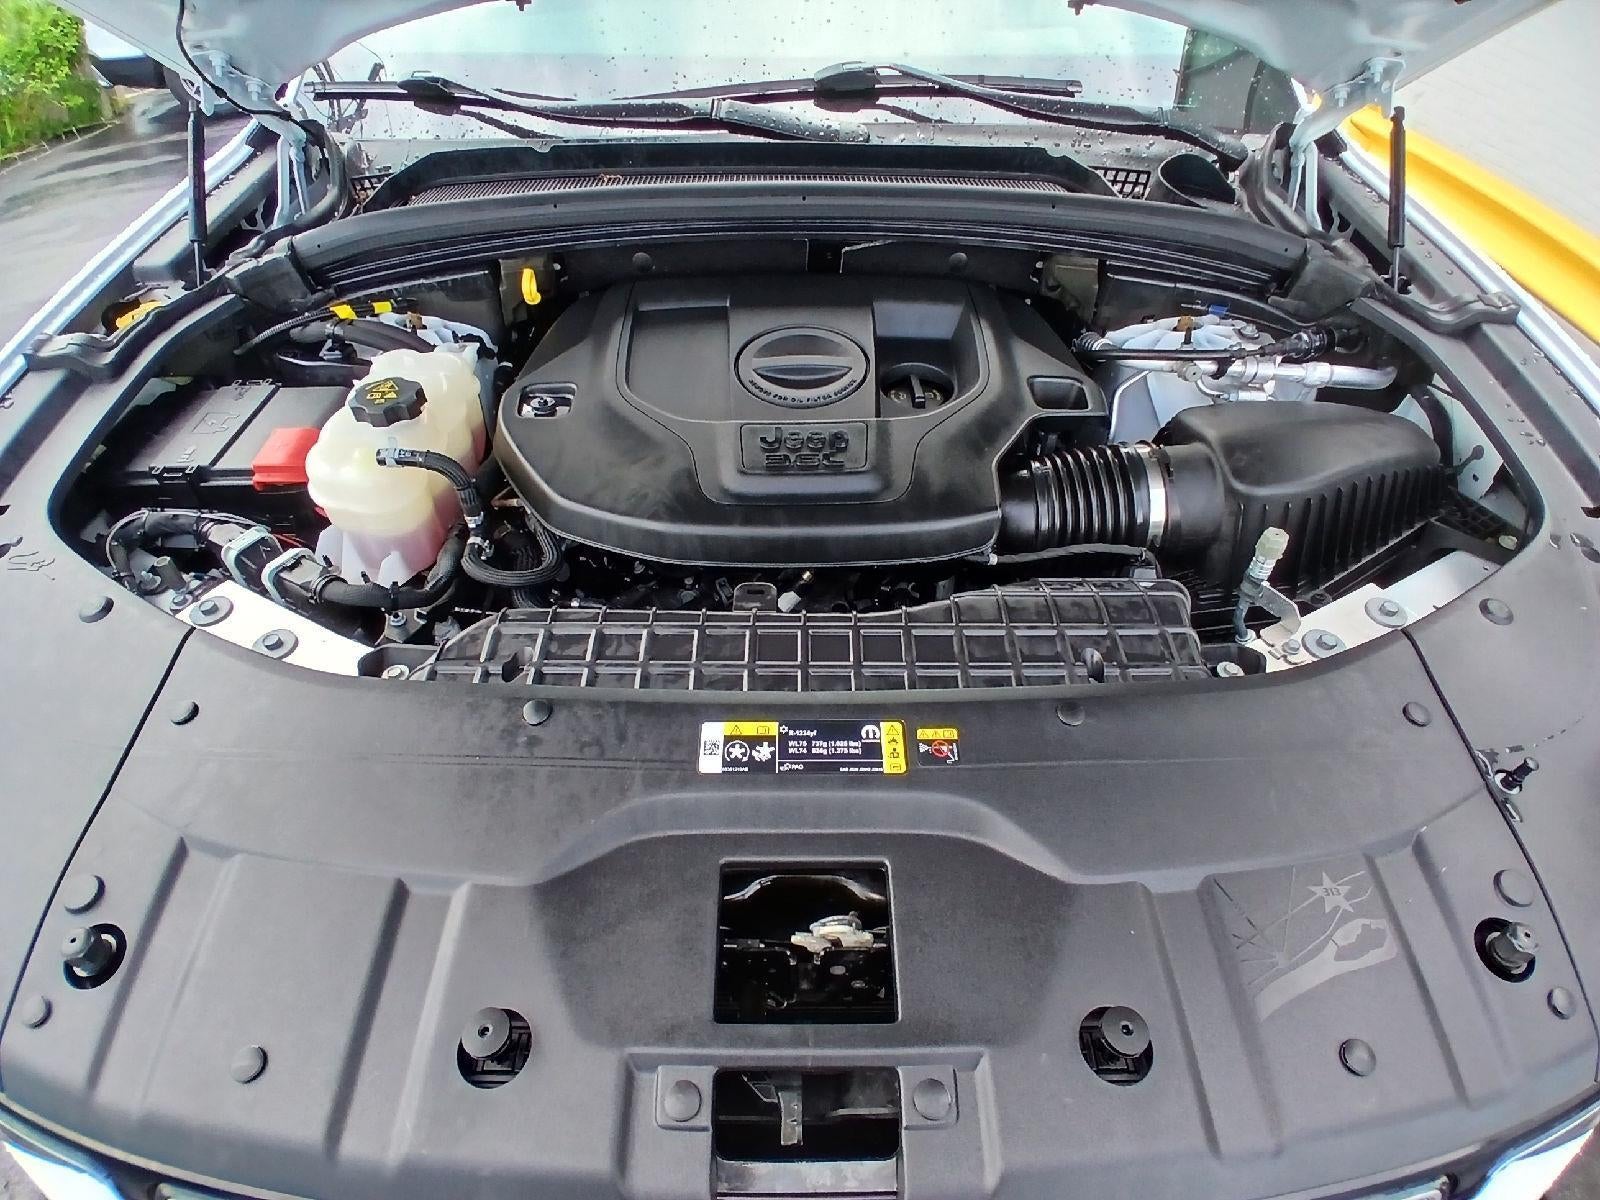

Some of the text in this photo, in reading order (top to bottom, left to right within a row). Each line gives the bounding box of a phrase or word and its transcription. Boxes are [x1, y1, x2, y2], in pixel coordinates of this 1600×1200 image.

[759, 427, 849, 451] Jeep
[765, 452, 845, 468] 3.6L
[1321, 887, 1341, 897] 313
